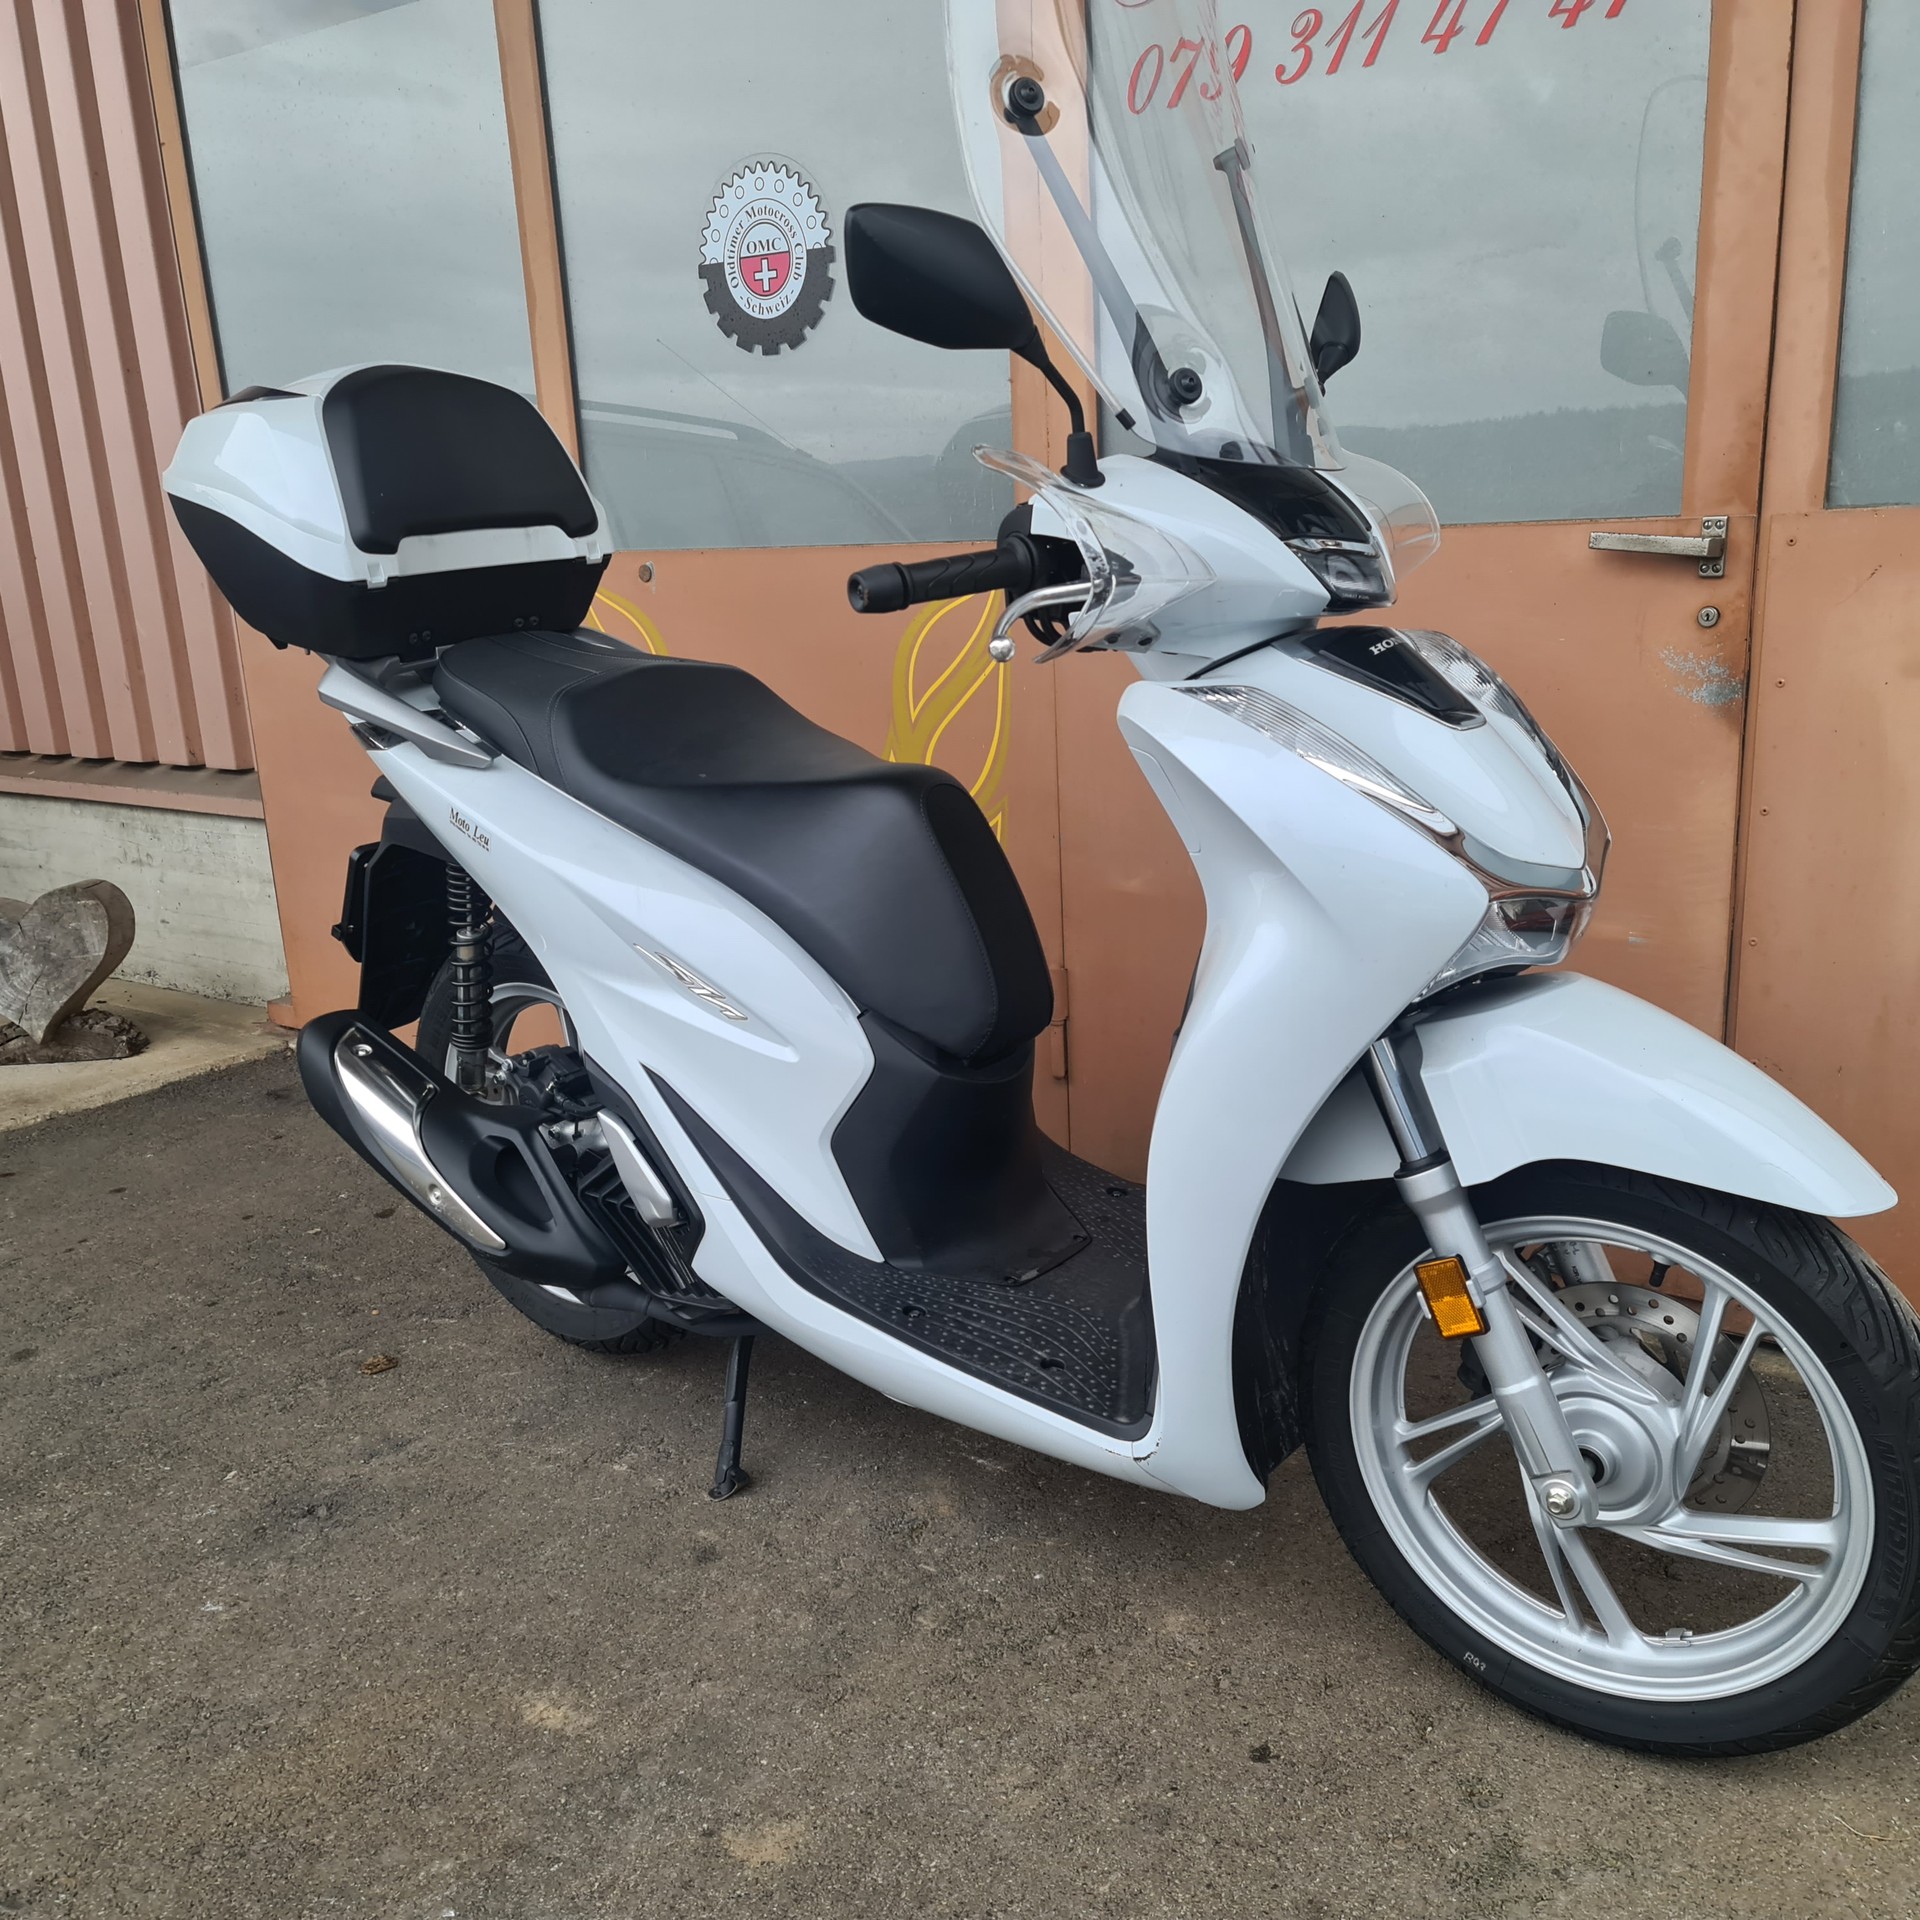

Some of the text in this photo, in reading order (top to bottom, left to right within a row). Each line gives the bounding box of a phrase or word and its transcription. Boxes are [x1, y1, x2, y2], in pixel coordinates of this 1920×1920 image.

[1275, 0, 1401, 85] 311
[727, 205, 804, 289] Oldtimer Motocross Club
[746, 237, 782, 255] OMC
[744, 294, 792, 315] Schweiz
[449, 807, 470, 832] Moto
[473, 825, 490, 846] Leu
